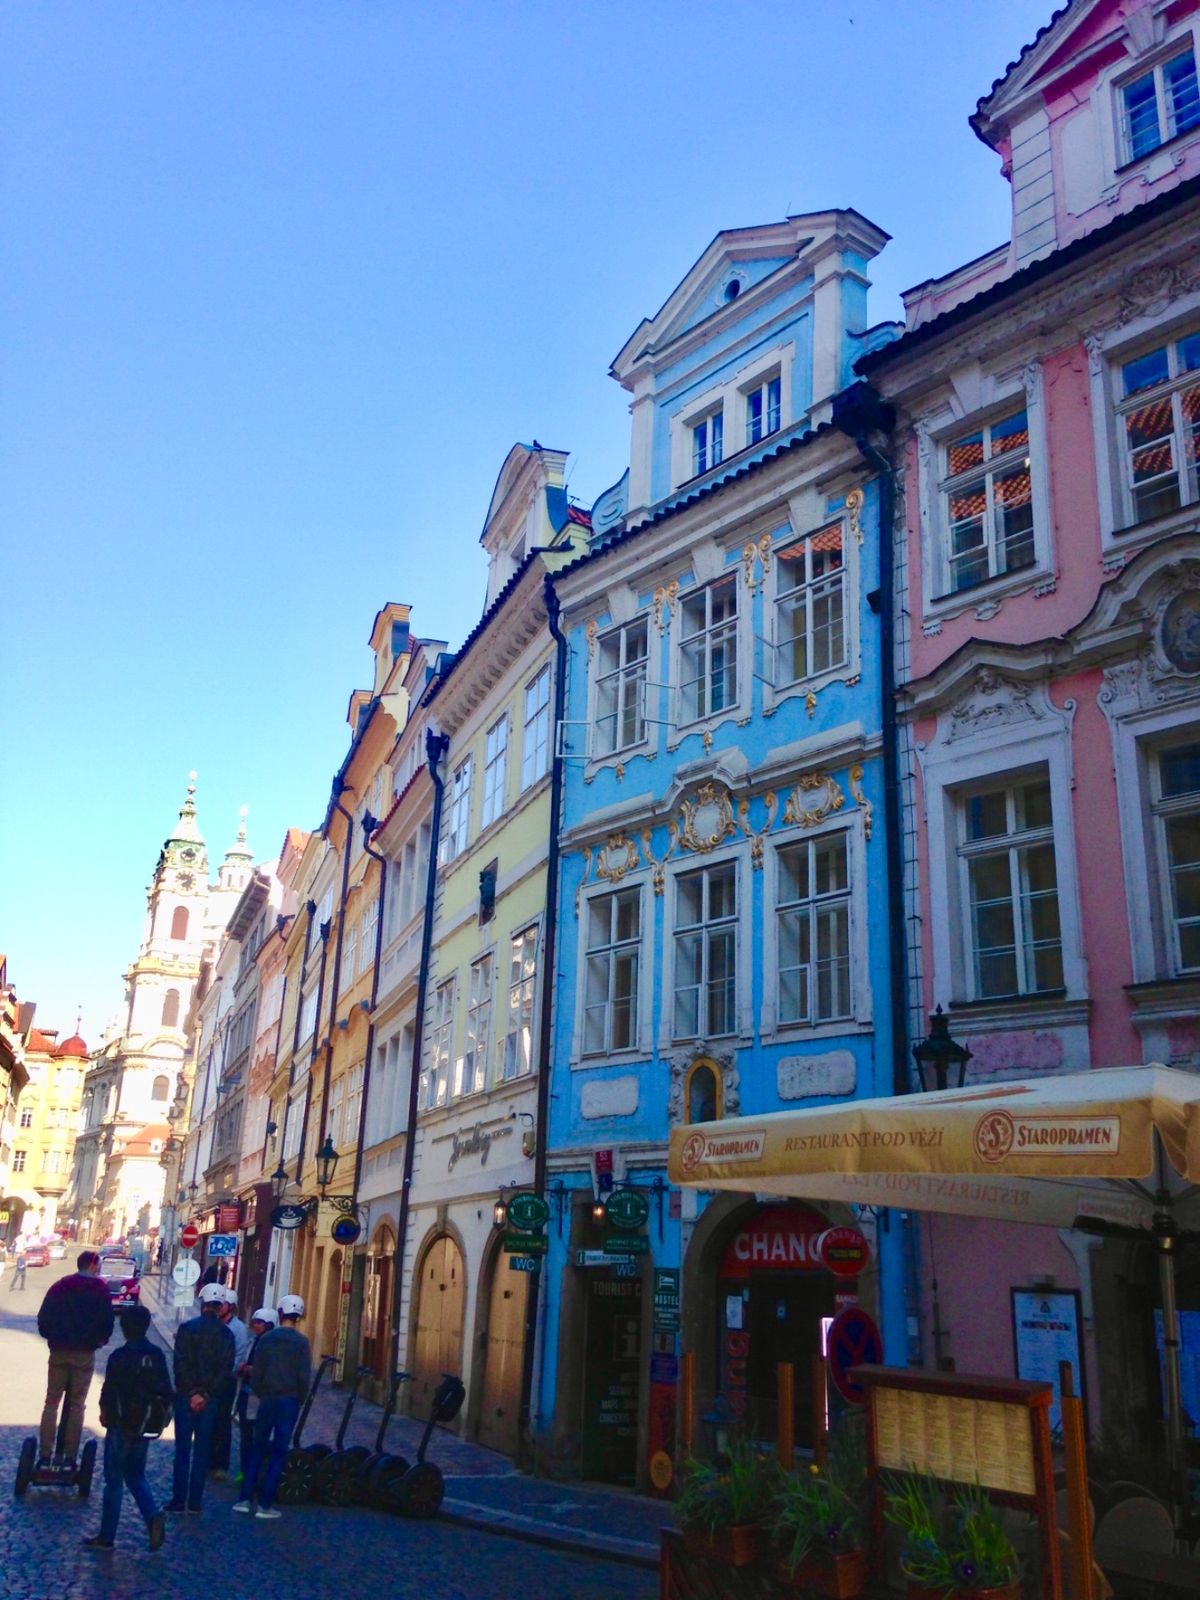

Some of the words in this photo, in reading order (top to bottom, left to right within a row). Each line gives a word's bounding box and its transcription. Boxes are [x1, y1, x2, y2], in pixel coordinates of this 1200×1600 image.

[784, 1131, 871, 1152] RESTAURANT
[872, 1131, 906, 1147] POD
[908, 1127, 945, 1147] VĚŽÍ
[1017, 1124, 1112, 1147] STAROPRAMEN
[704, 1139, 761, 1158] STAROPRAMEN
[738, 1232, 822, 1262] CHANG
[515, 1258, 535, 1271] WC
[616, 1264, 637, 1276] WC
[592, 1281, 632, 1296] TOURIST
[654, 1295, 679, 1306] HOSTEL
